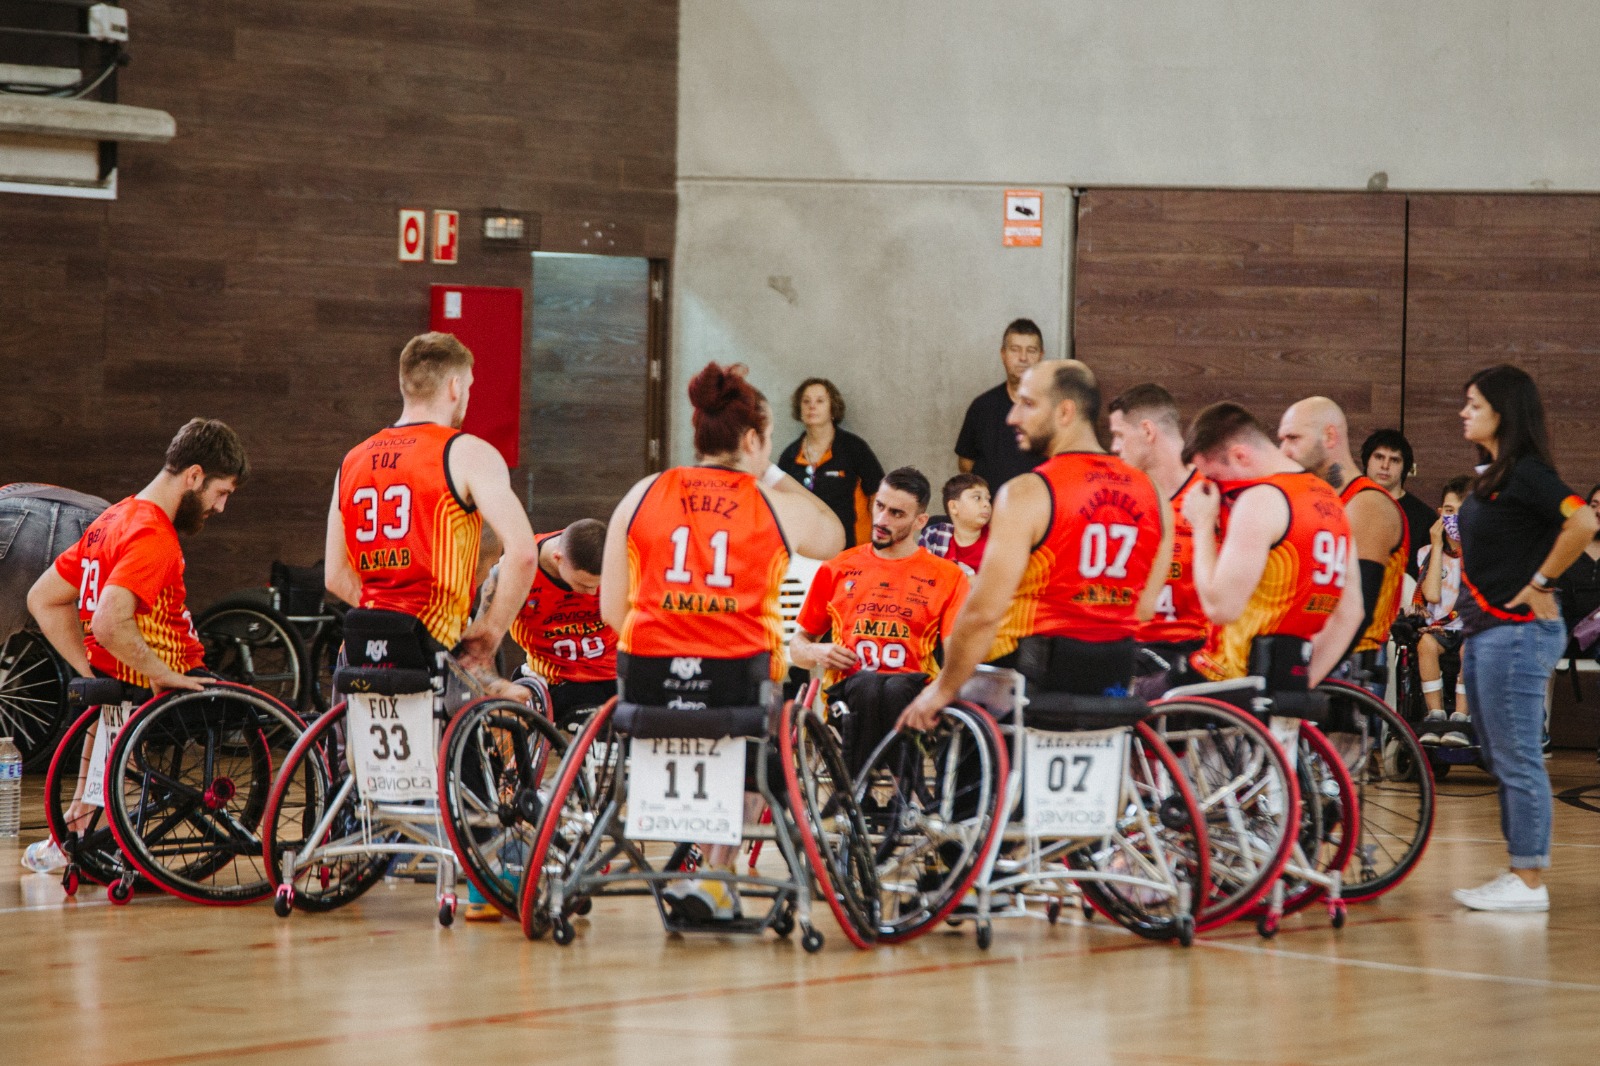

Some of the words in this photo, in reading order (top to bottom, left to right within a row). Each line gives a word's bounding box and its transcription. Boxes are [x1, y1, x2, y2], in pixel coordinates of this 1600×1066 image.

[371, 452, 402, 471] FOX
[353, 484, 412, 542] 33
[664, 525, 733, 588] 11
[1078, 522, 1139, 579] 07
[1312, 529, 1348, 588] 94
[856, 602, 913, 618] gaviota
[368, 697, 400, 719] FOX
[370, 724, 411, 761] 33
[367, 775, 432, 792] gaviota
[664, 760, 708, 800] 11
[1048, 755, 1094, 793] 07
[638, 815, 730, 832] gaviota
